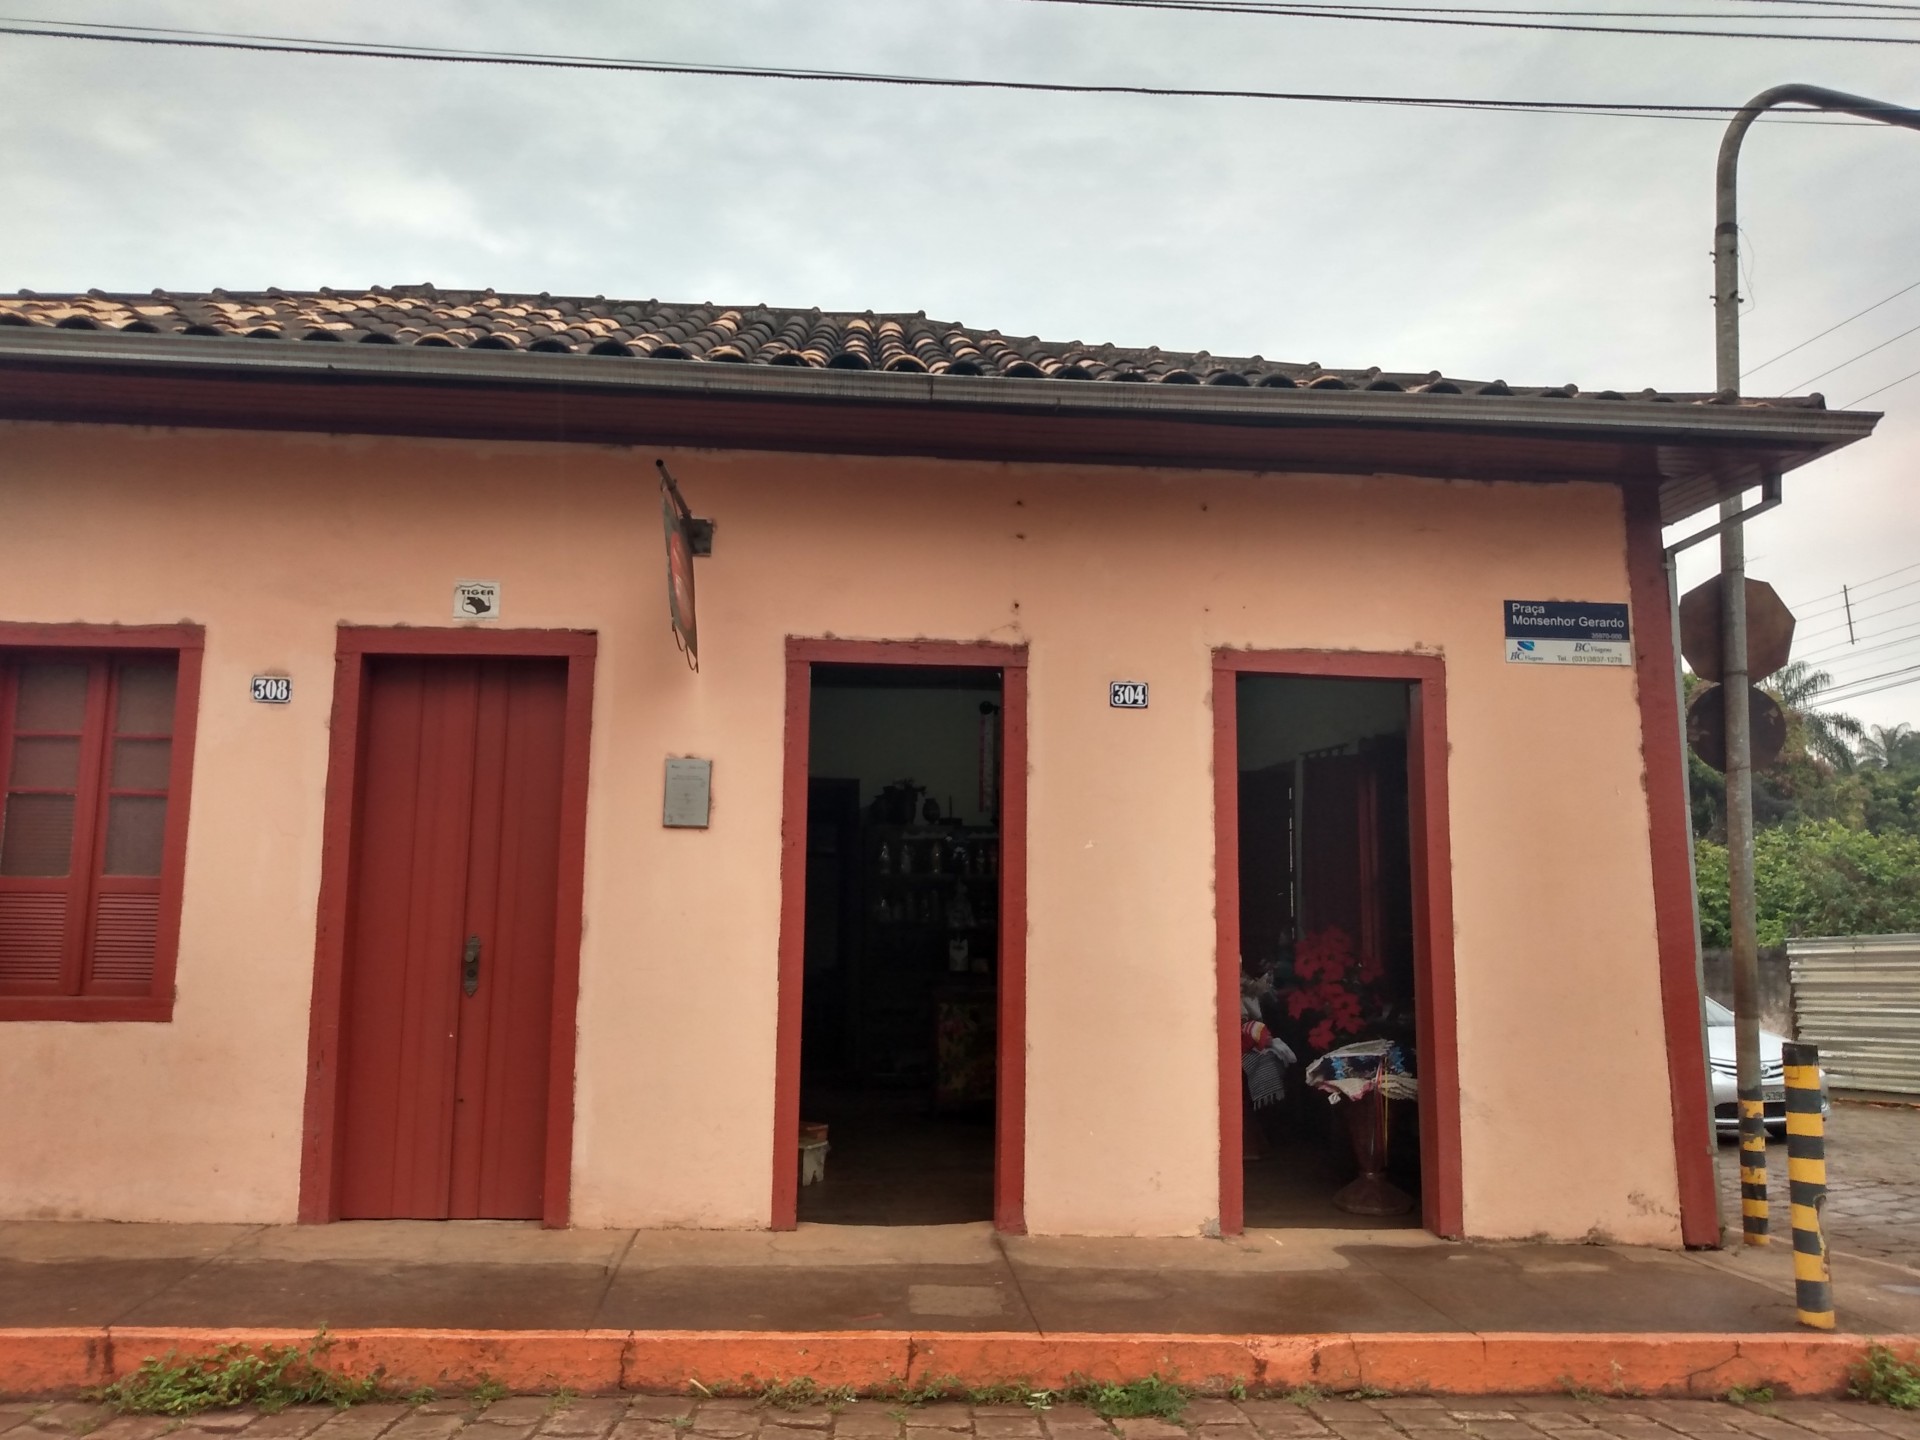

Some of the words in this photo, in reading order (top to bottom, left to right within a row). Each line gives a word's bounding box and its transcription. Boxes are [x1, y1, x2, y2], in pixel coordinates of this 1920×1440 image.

[1512, 603, 1545, 616] Praça
[1512, 615, 1576, 627] Monsenhor
[1579, 616, 1625, 628] Gerardo
[1574, 642, 1591, 653] BC
[254, 679, 288, 700] 308
[1114, 685, 1145, 704] 304
